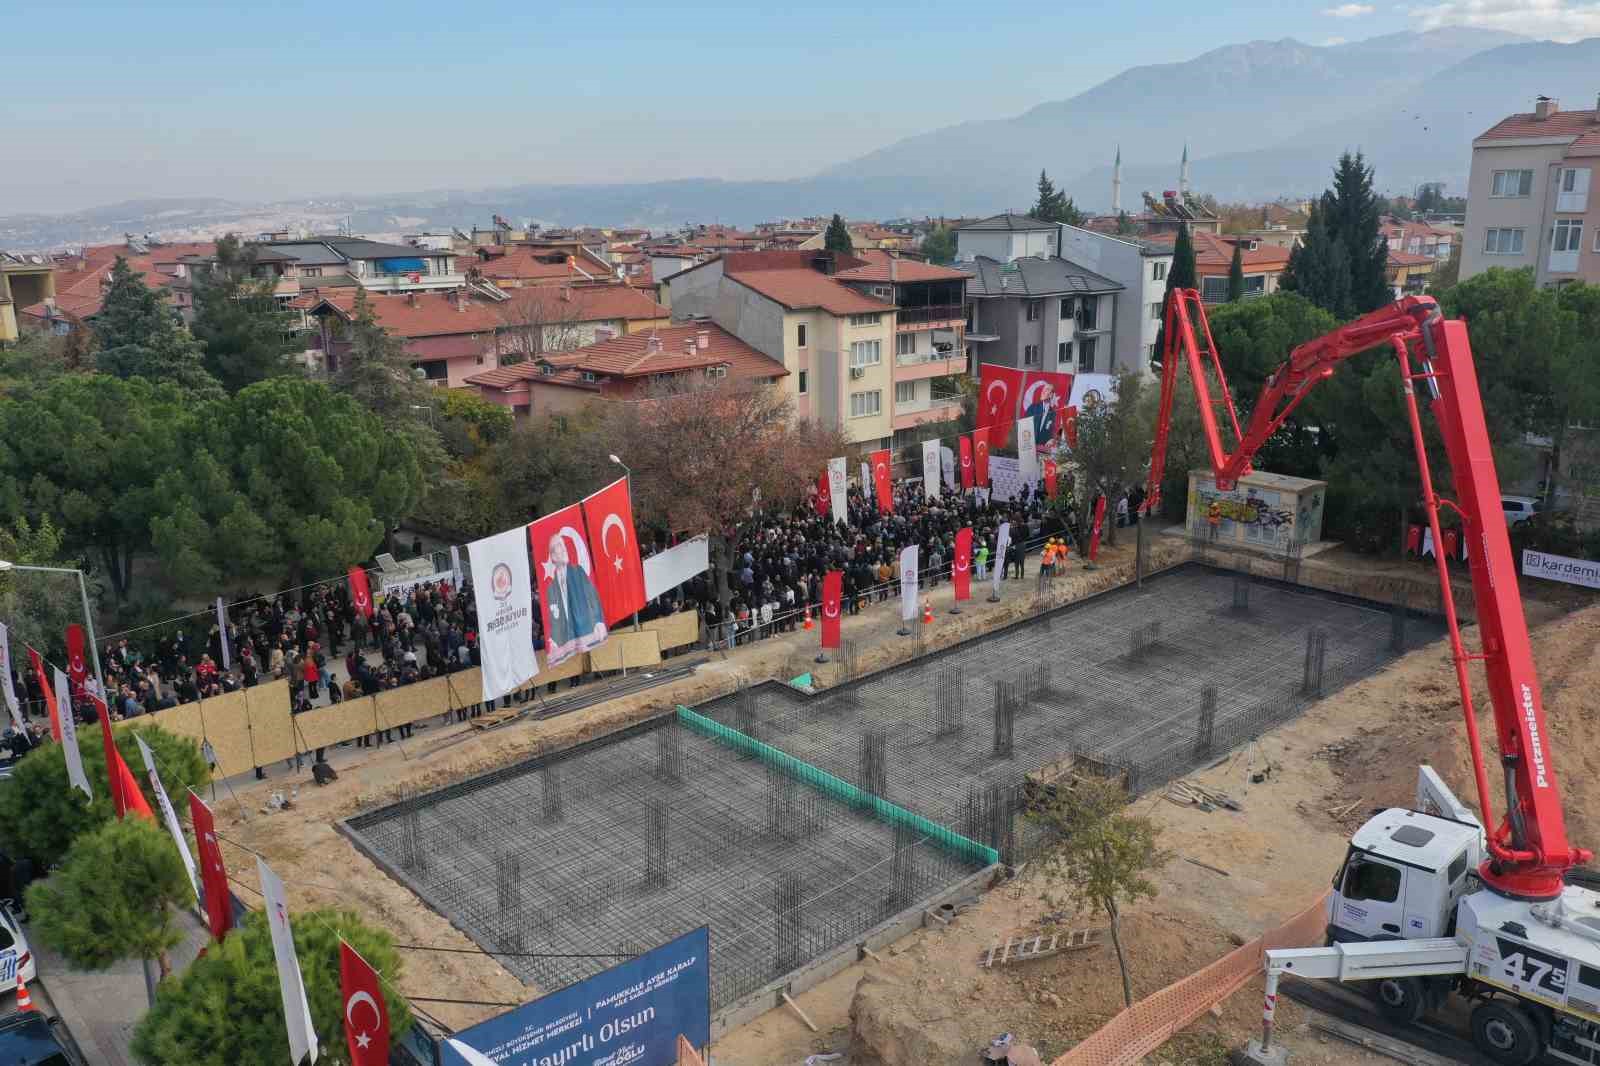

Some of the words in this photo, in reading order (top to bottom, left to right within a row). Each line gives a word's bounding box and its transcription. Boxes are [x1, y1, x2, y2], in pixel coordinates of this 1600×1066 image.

[1542, 557, 1600, 577] kardemi
[1521, 683, 1550, 788] Putzmeister
[596, 981, 645, 1009] PAMUKKALE
[599, 1006, 655, 1042] Olsun
